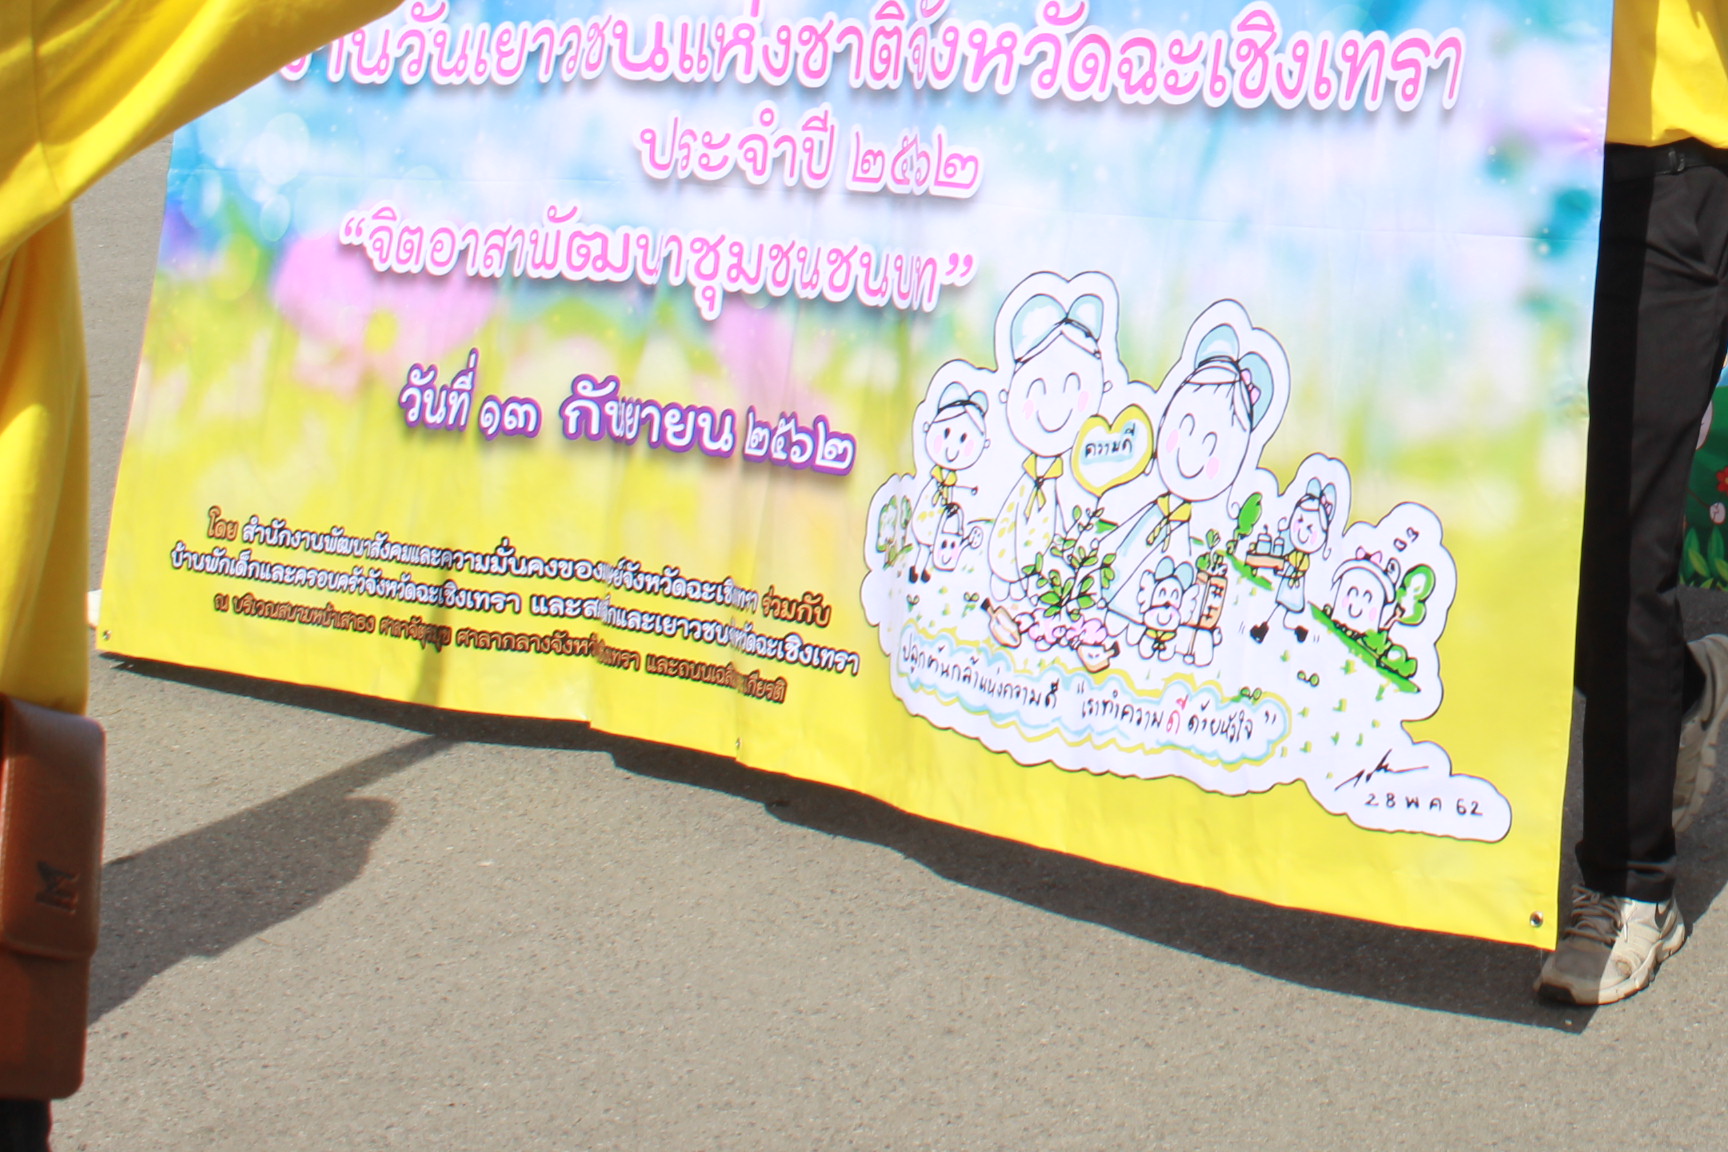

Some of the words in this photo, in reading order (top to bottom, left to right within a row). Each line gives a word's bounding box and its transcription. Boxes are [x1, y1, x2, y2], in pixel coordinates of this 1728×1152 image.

[638, 106, 836, 189] ประจำปี
[853, 128, 980, 191] ๒๕๖๒
[342, 203, 974, 314] “จิตอาสาพัฒนาชุมชนชนบท”
[400, 348, 479, 429] วันที่
[478, 391, 541, 441] ๑๓
[561, 374, 735, 457] กันยายน
[743, 405, 856, 476] ๒๕๖๒
[1084, 422, 1136, 458] ความดี
[207, 505, 239, 541] โดย
[761, 585, 832, 627] ร่วมกับ
[1364, 792, 1397, 808] 28
[1456, 798, 1484, 816] 62
